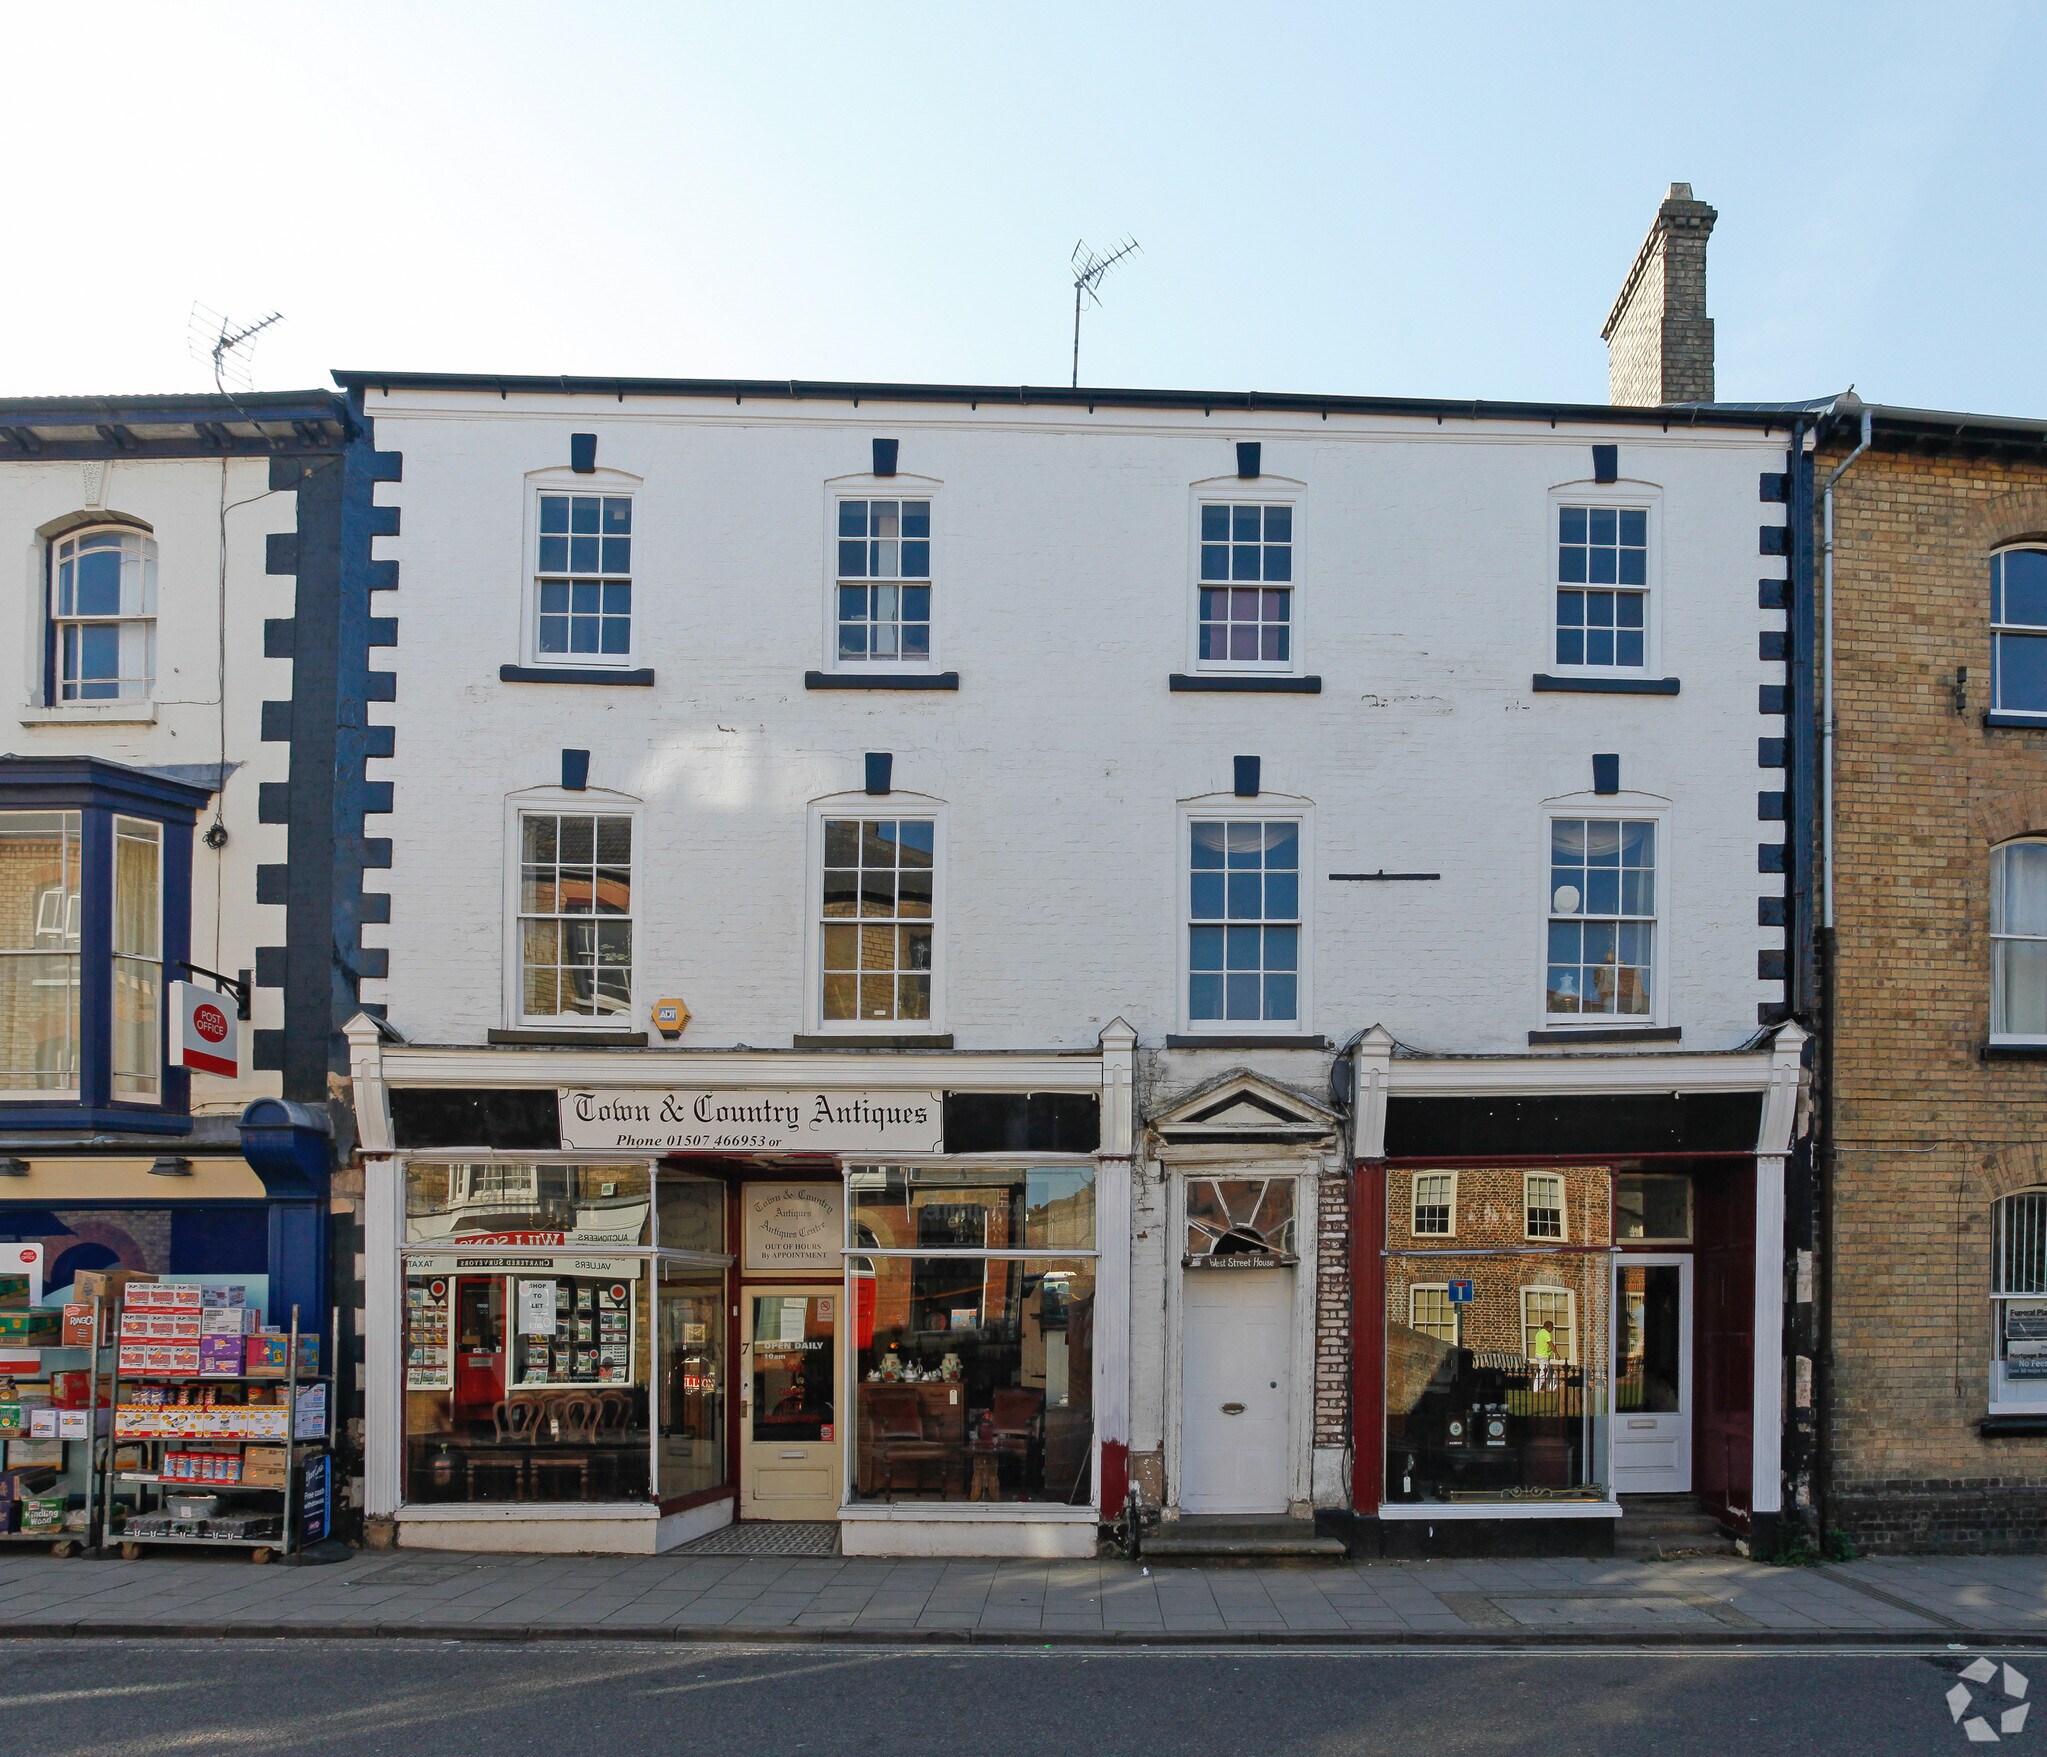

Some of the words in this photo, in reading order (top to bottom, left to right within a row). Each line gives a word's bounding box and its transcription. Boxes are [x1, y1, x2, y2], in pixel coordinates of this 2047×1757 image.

[201, 1010, 221, 1024] POST
[659, 1009, 676, 1019] ADT
[196, 1020, 224, 1036] OFFICE
[573, 1093, 650, 1122] Town
[660, 1094, 685, 1123] &
[693, 1094, 800, 1132] Country
[808, 1094, 928, 1133] Antiques
[616, 1134, 662, 1147] Phone
[666, 1135, 710, 1147] 01507
[714, 1135, 766, 1148] 466953
[769, 1138, 782, 1147] or
[754, 1194, 781, 1212] Town
[782, 1189, 794, 1200] &
[797, 1189, 833, 1215] Country
[774, 1207, 812, 1220] Antiques
[760, 1220, 797, 1240] Antiques
[799, 1222, 826, 1237] Centre
[761, 1252, 770, 1260] By
[1209, 1257, 1226, 1267] West
[1227, 1257, 1251, 1267] Street
[1253, 1257, 1275, 1267] House
[2010, 1309, 2036, 1317] Funeral
[69, 1315, 94, 1326] RINGO
[742, 1342, 750, 1355] 7
[764, 1342, 791, 1350] OPEN
[794, 1342, 824, 1350] DAILY
[304, 1491, 314, 1500] Free
[314, 1488, 325, 1497] cash
[25, 1508, 59, 1519] Kindling
[30, 1517, 52, 1525] Wood
